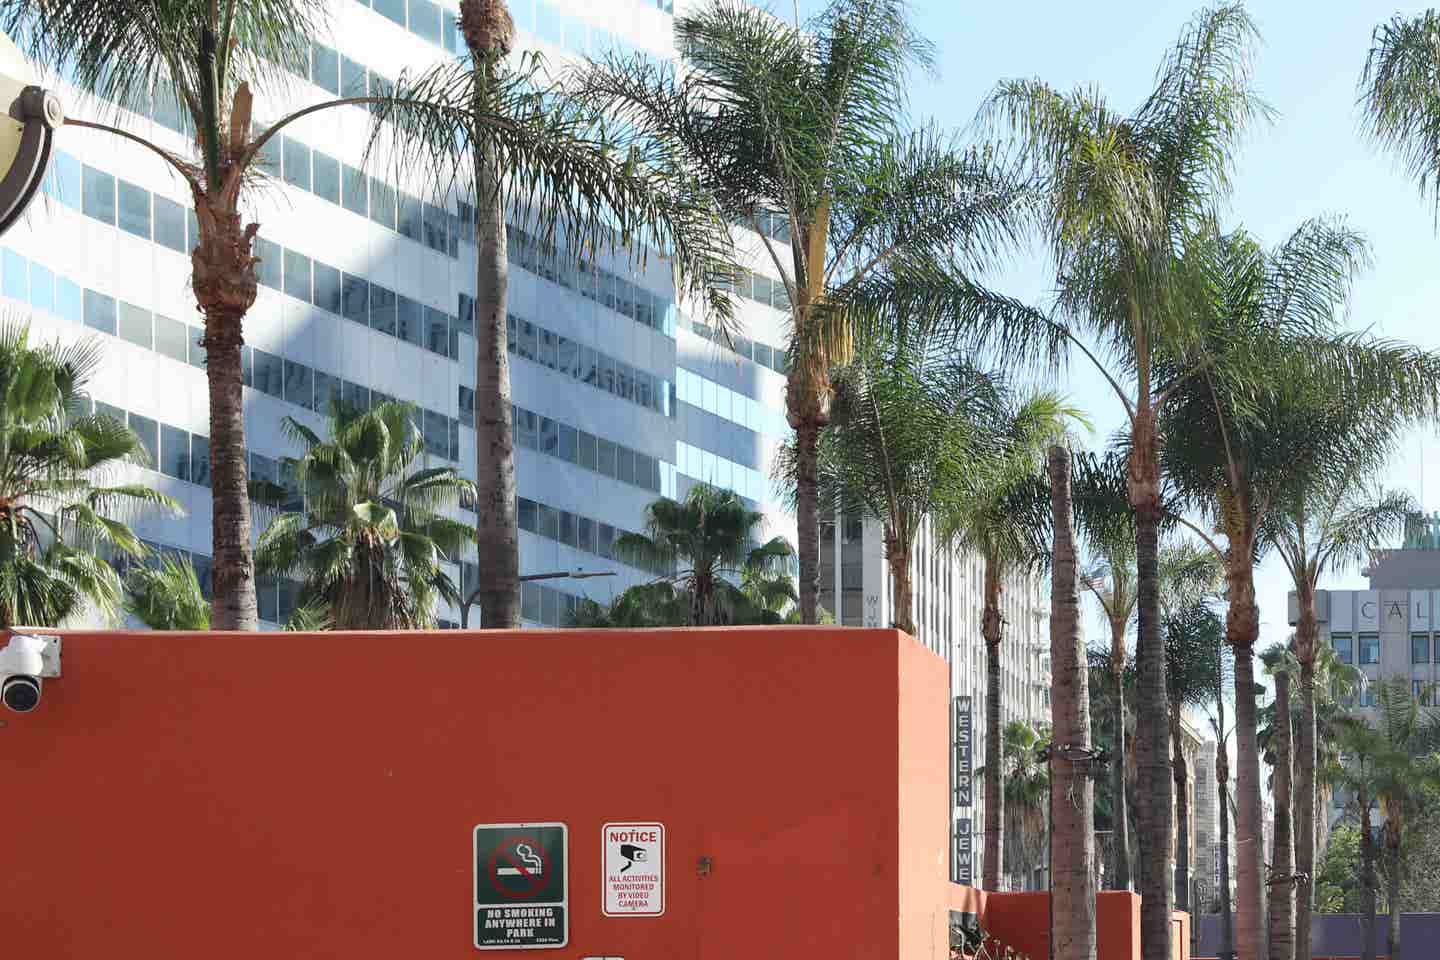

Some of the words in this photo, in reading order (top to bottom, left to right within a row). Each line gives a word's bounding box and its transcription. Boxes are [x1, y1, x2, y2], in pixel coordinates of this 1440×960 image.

[957, 699, 971, 803] WESTERN
[610, 831, 657, 842] NOTICE
[609, 874, 621, 882] ALL
[622, 874, 658, 882] ACTIVITIES
[613, 883, 655, 891] MONITORED
[487, 908, 501, 919] NO
[503, 907, 554, 918] SMOKING
[484, 918, 542, 929] ANYWHERE
[544, 917, 556, 928] IN
[506, 927, 535, 938] PARK
